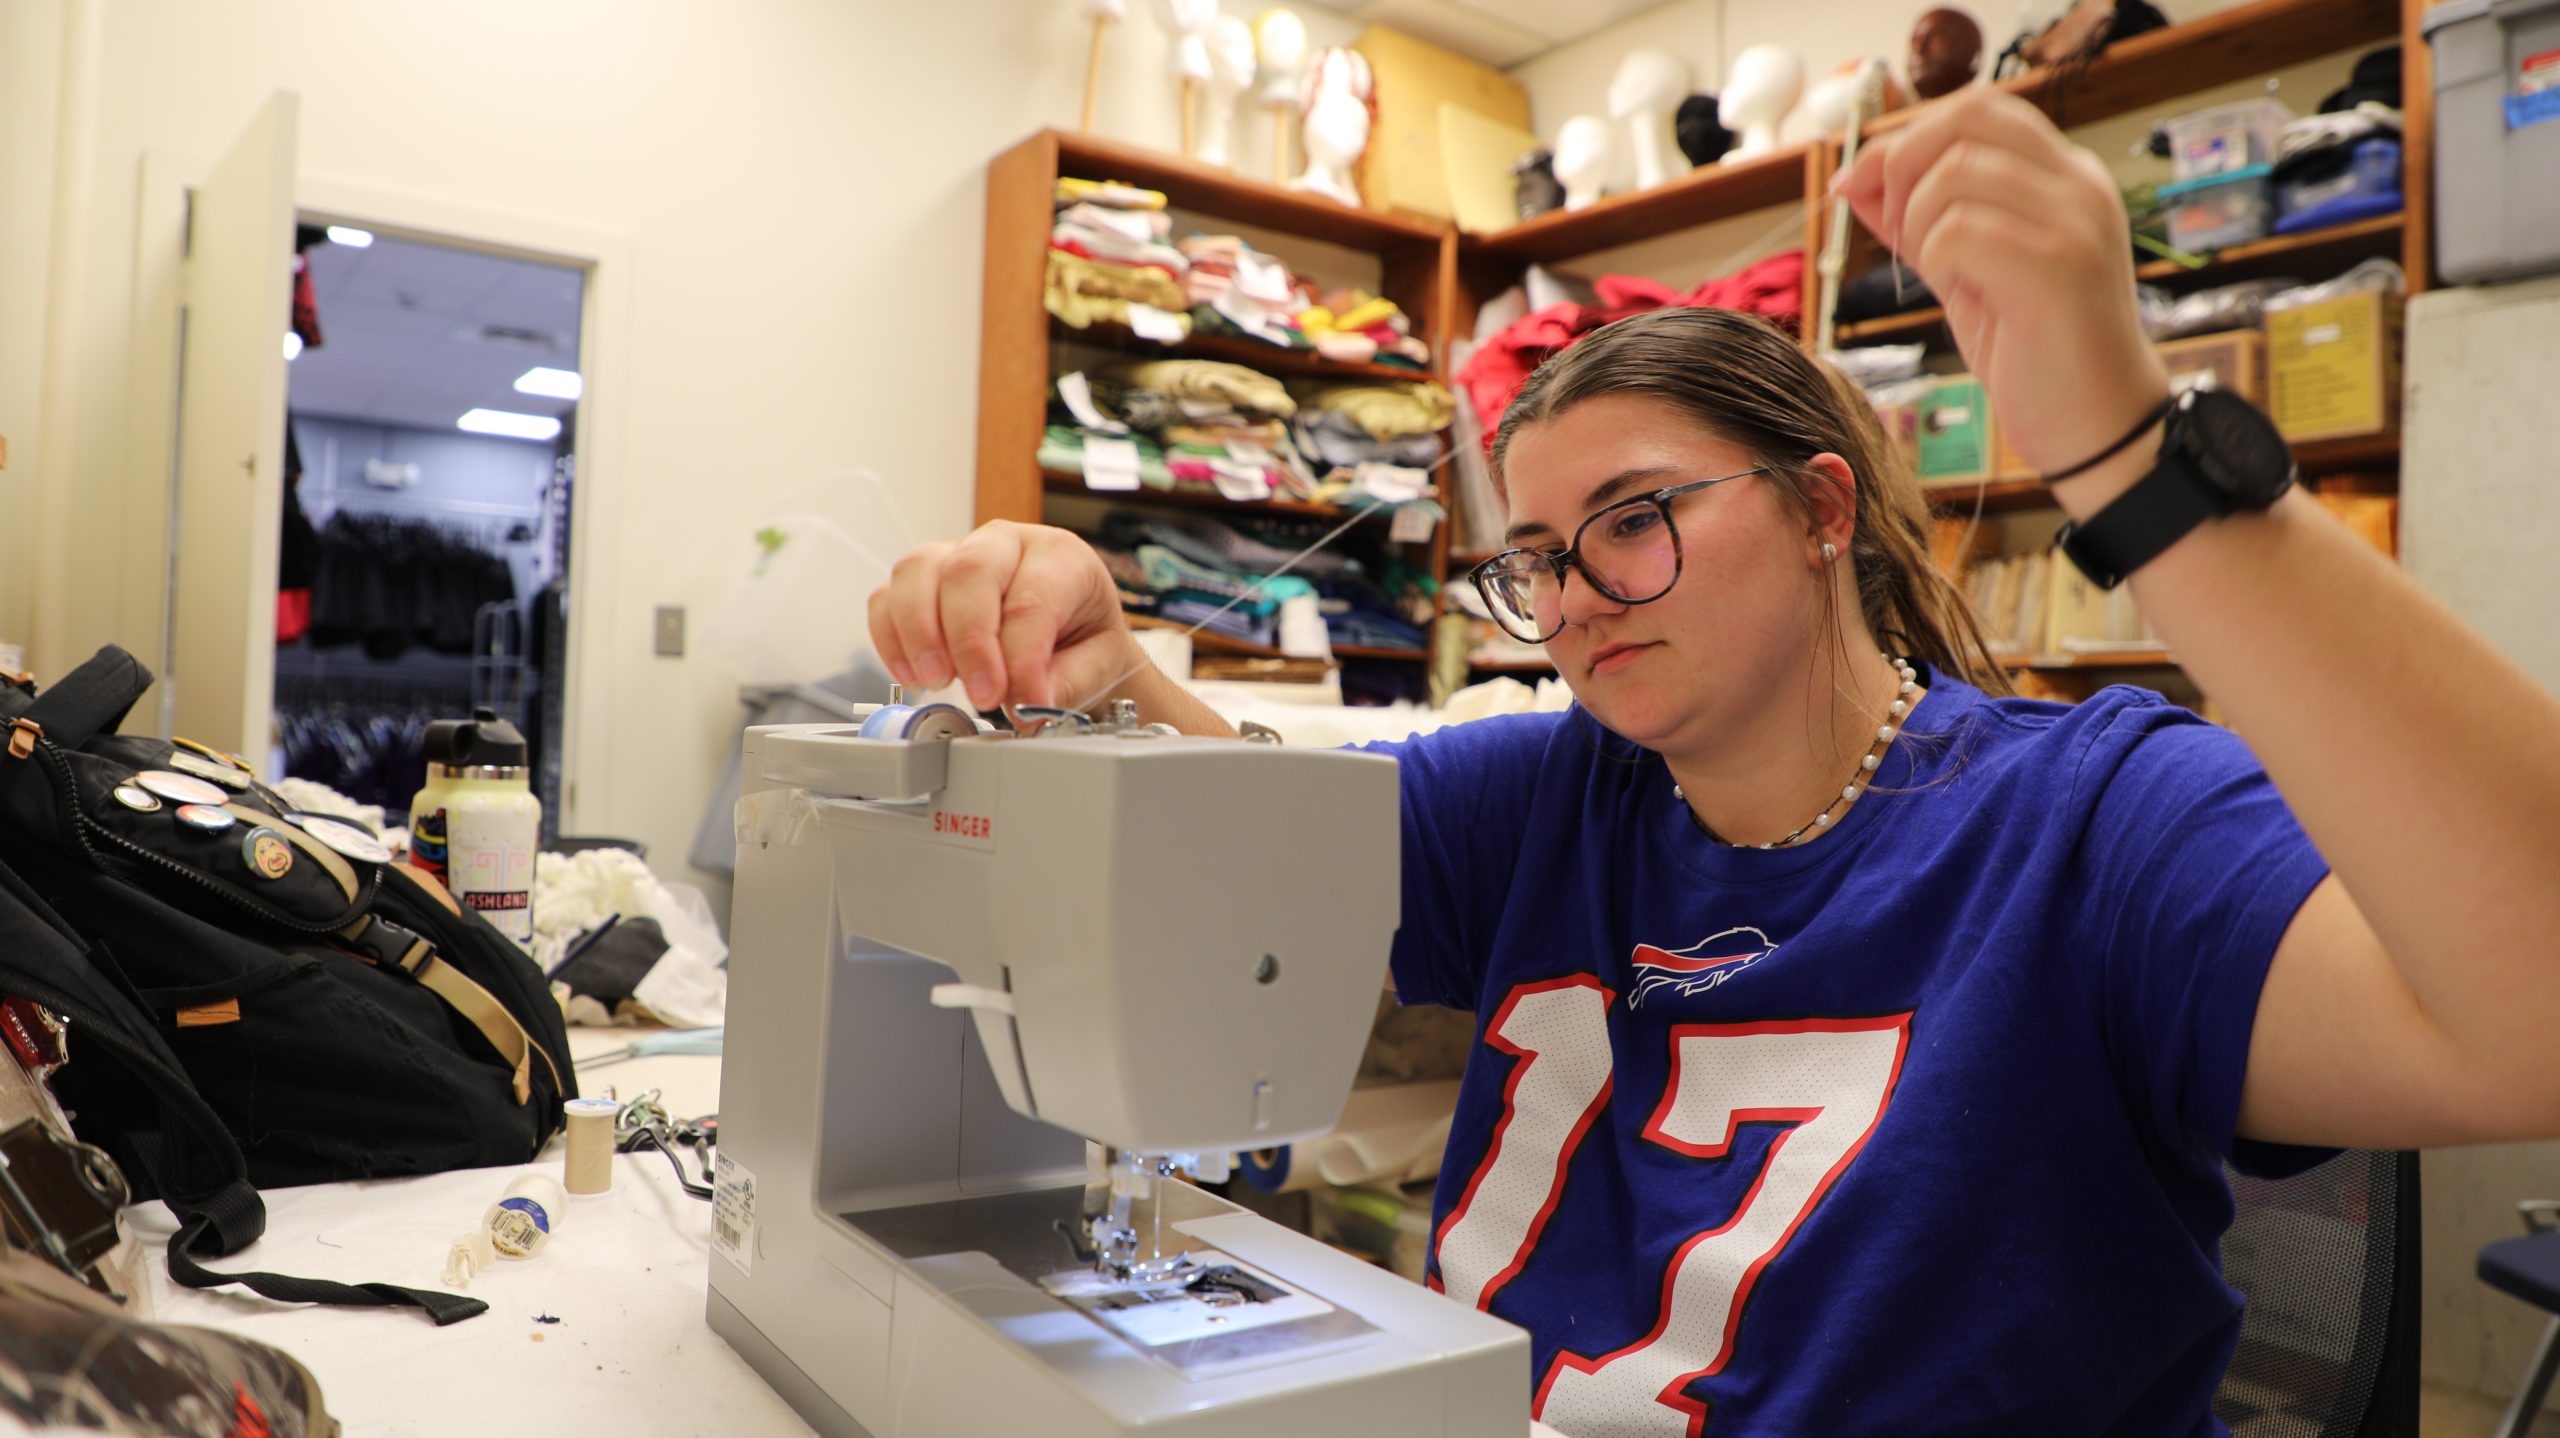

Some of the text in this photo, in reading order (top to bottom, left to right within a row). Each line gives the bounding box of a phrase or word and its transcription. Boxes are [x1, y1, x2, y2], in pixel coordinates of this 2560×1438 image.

[933, 810, 992, 840] SINGER
[466, 892, 528, 909] ASHLAND
[1427, 970, 1916, 1438] 17
